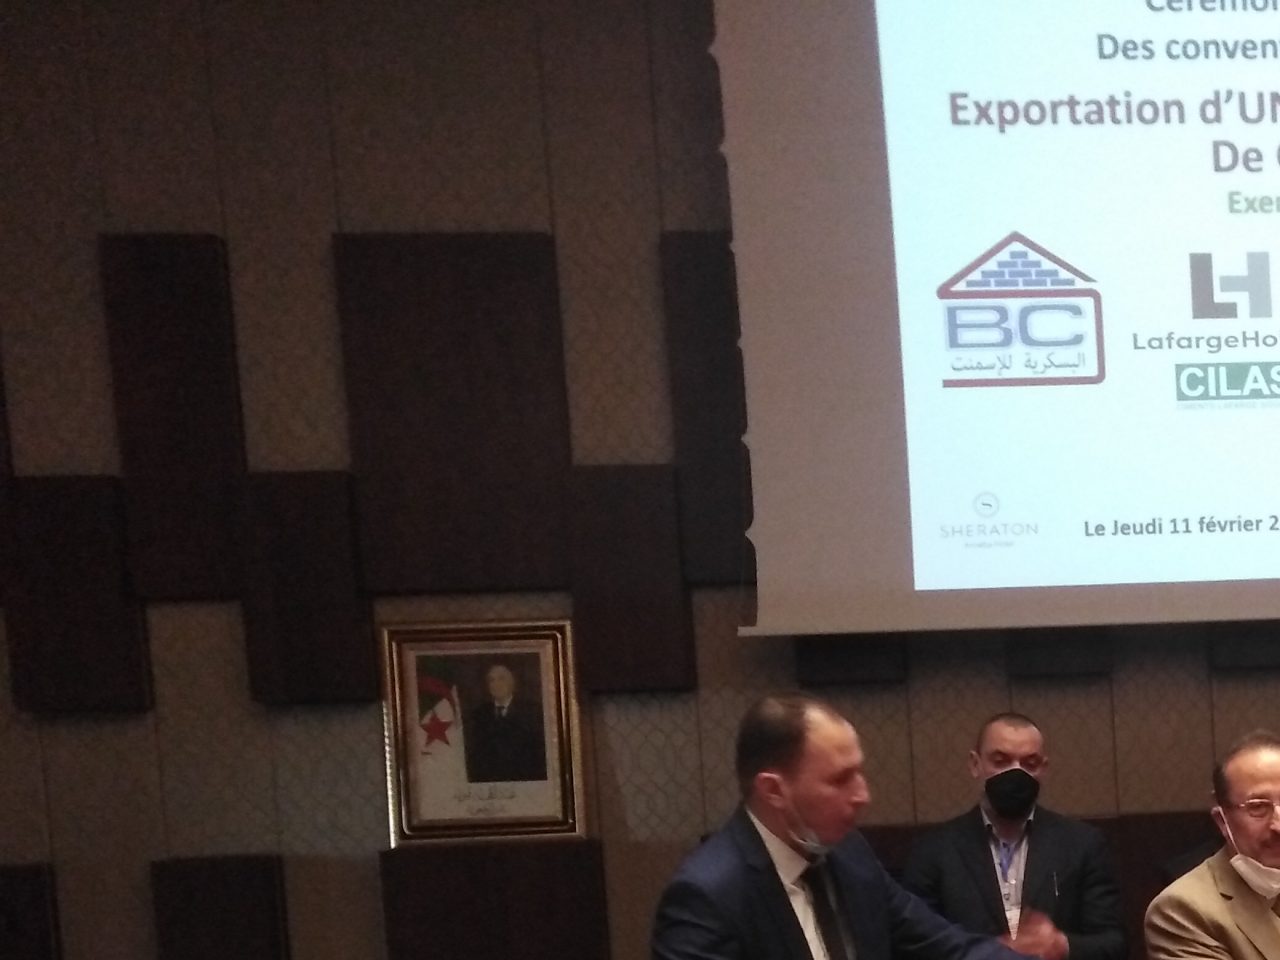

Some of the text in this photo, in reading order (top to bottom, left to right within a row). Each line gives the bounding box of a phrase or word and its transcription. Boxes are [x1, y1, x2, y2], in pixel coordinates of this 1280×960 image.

[1097, 33, 1156, 61] Des
[948, 90, 1186, 135] Exportation
[1212, 140, 1264, 173] De
[946, 304, 1084, 349] BC
[940, 522, 1039, 539] SHERATON
[1084, 520, 1106, 537] Le
[1111, 517, 1163, 536] Jeudi
[1169, 517, 1193, 535] 11
[1197, 515, 1263, 534] février
